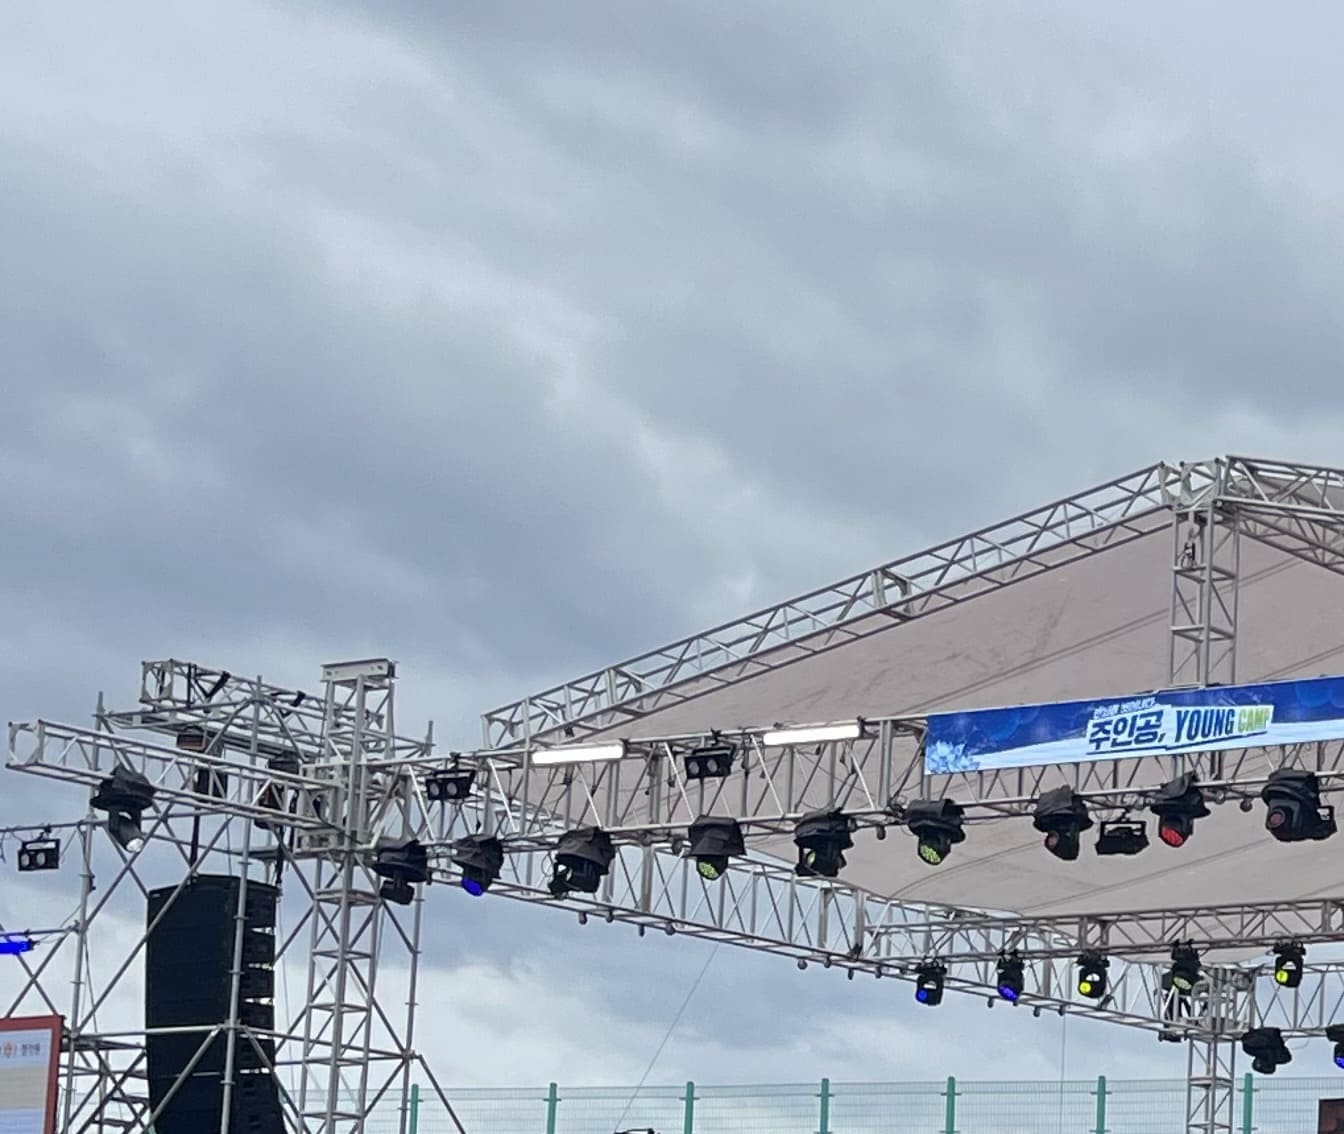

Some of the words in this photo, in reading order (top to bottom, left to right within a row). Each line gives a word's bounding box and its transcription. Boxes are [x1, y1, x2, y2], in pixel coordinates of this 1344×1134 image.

[1089, 710, 1166, 750] 주인공,
[1175, 709, 1236, 743] YOUNG
[1238, 707, 1271, 733] CAMP
